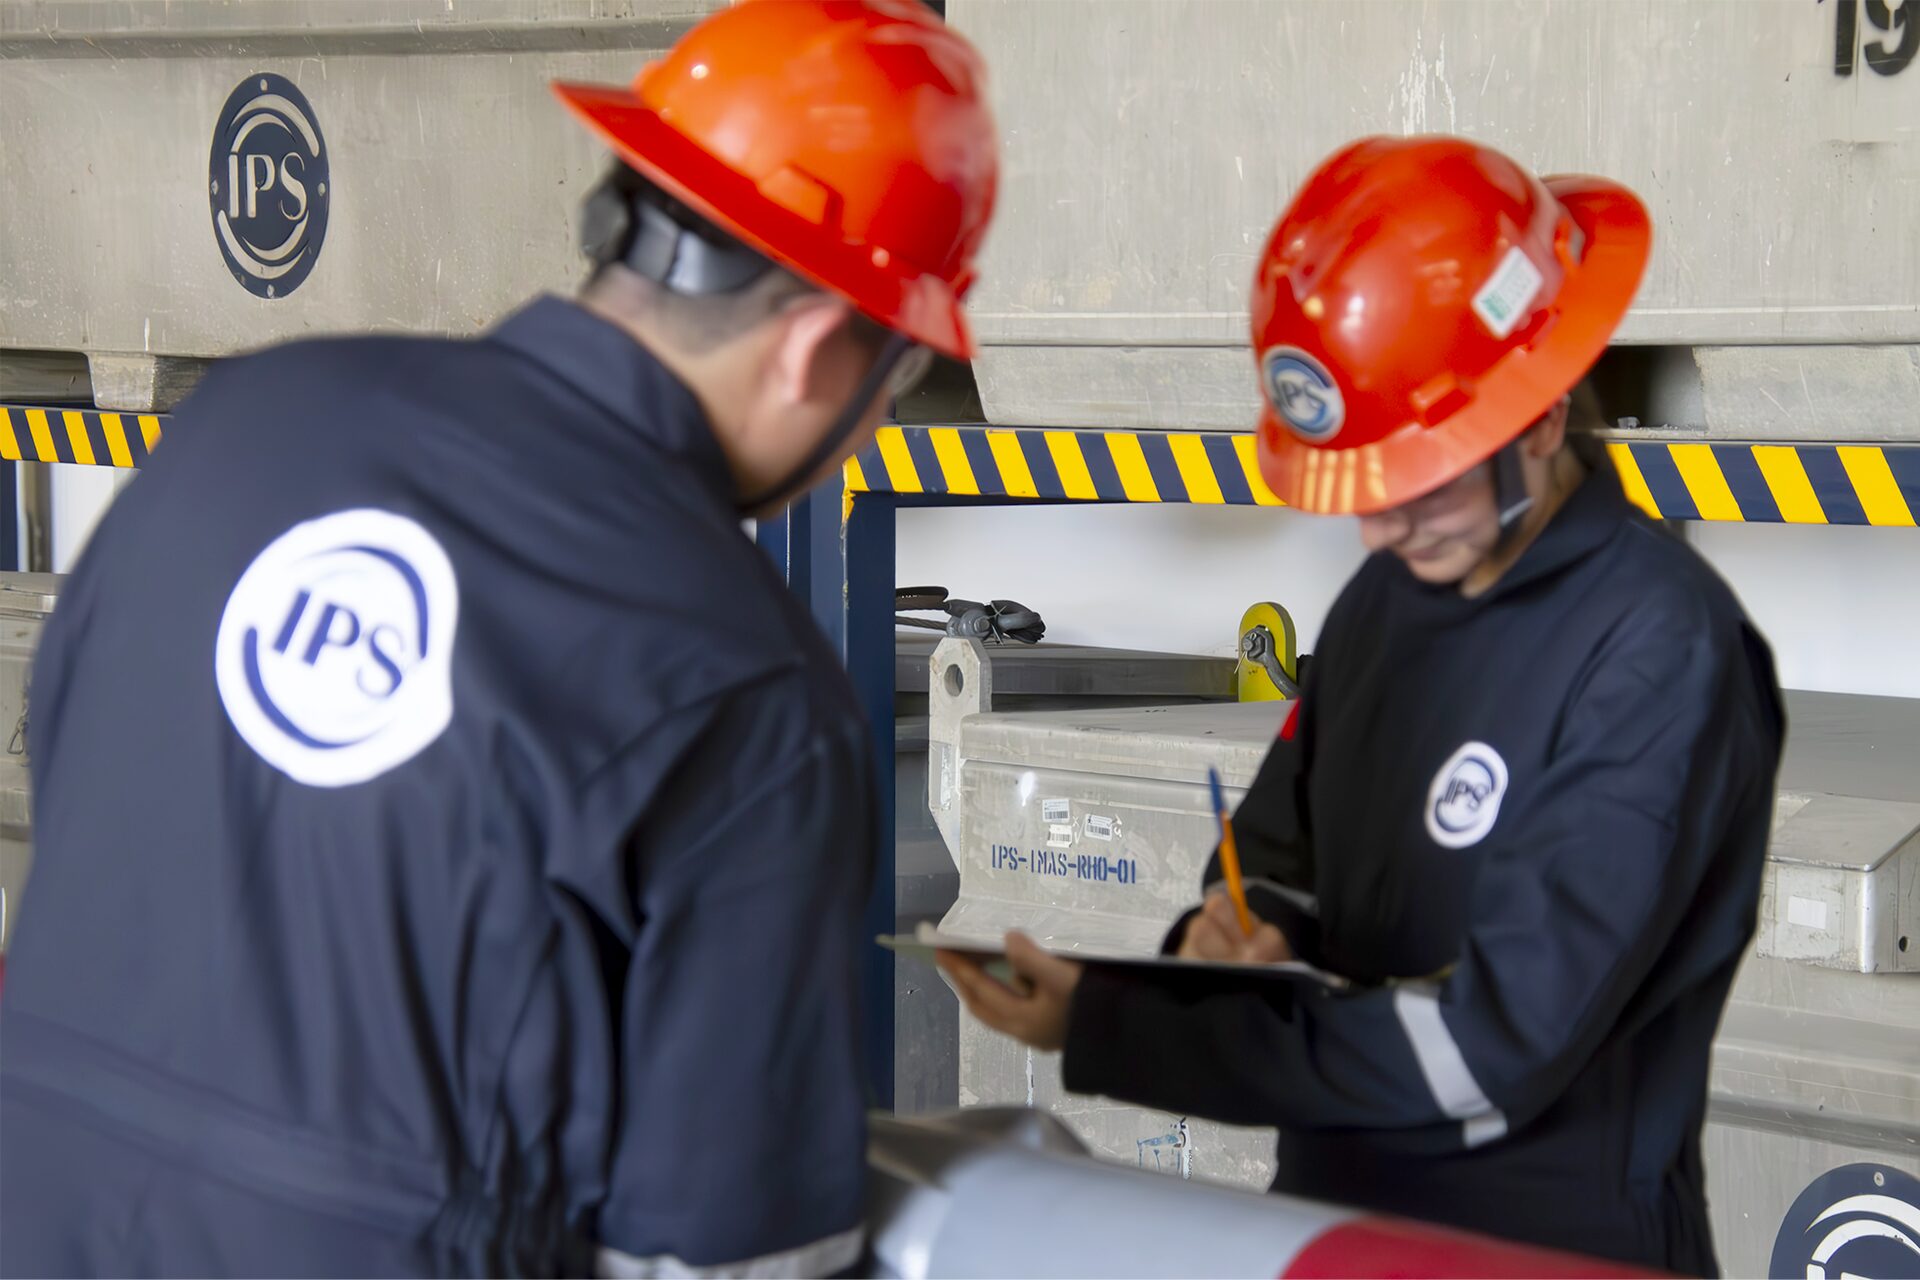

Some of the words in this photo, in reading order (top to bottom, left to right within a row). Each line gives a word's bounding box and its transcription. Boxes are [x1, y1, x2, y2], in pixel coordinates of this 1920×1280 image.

[229, 151, 307, 220] IPS
[273, 589, 405, 699] IPS
[1443, 777, 1490, 812] IPS
